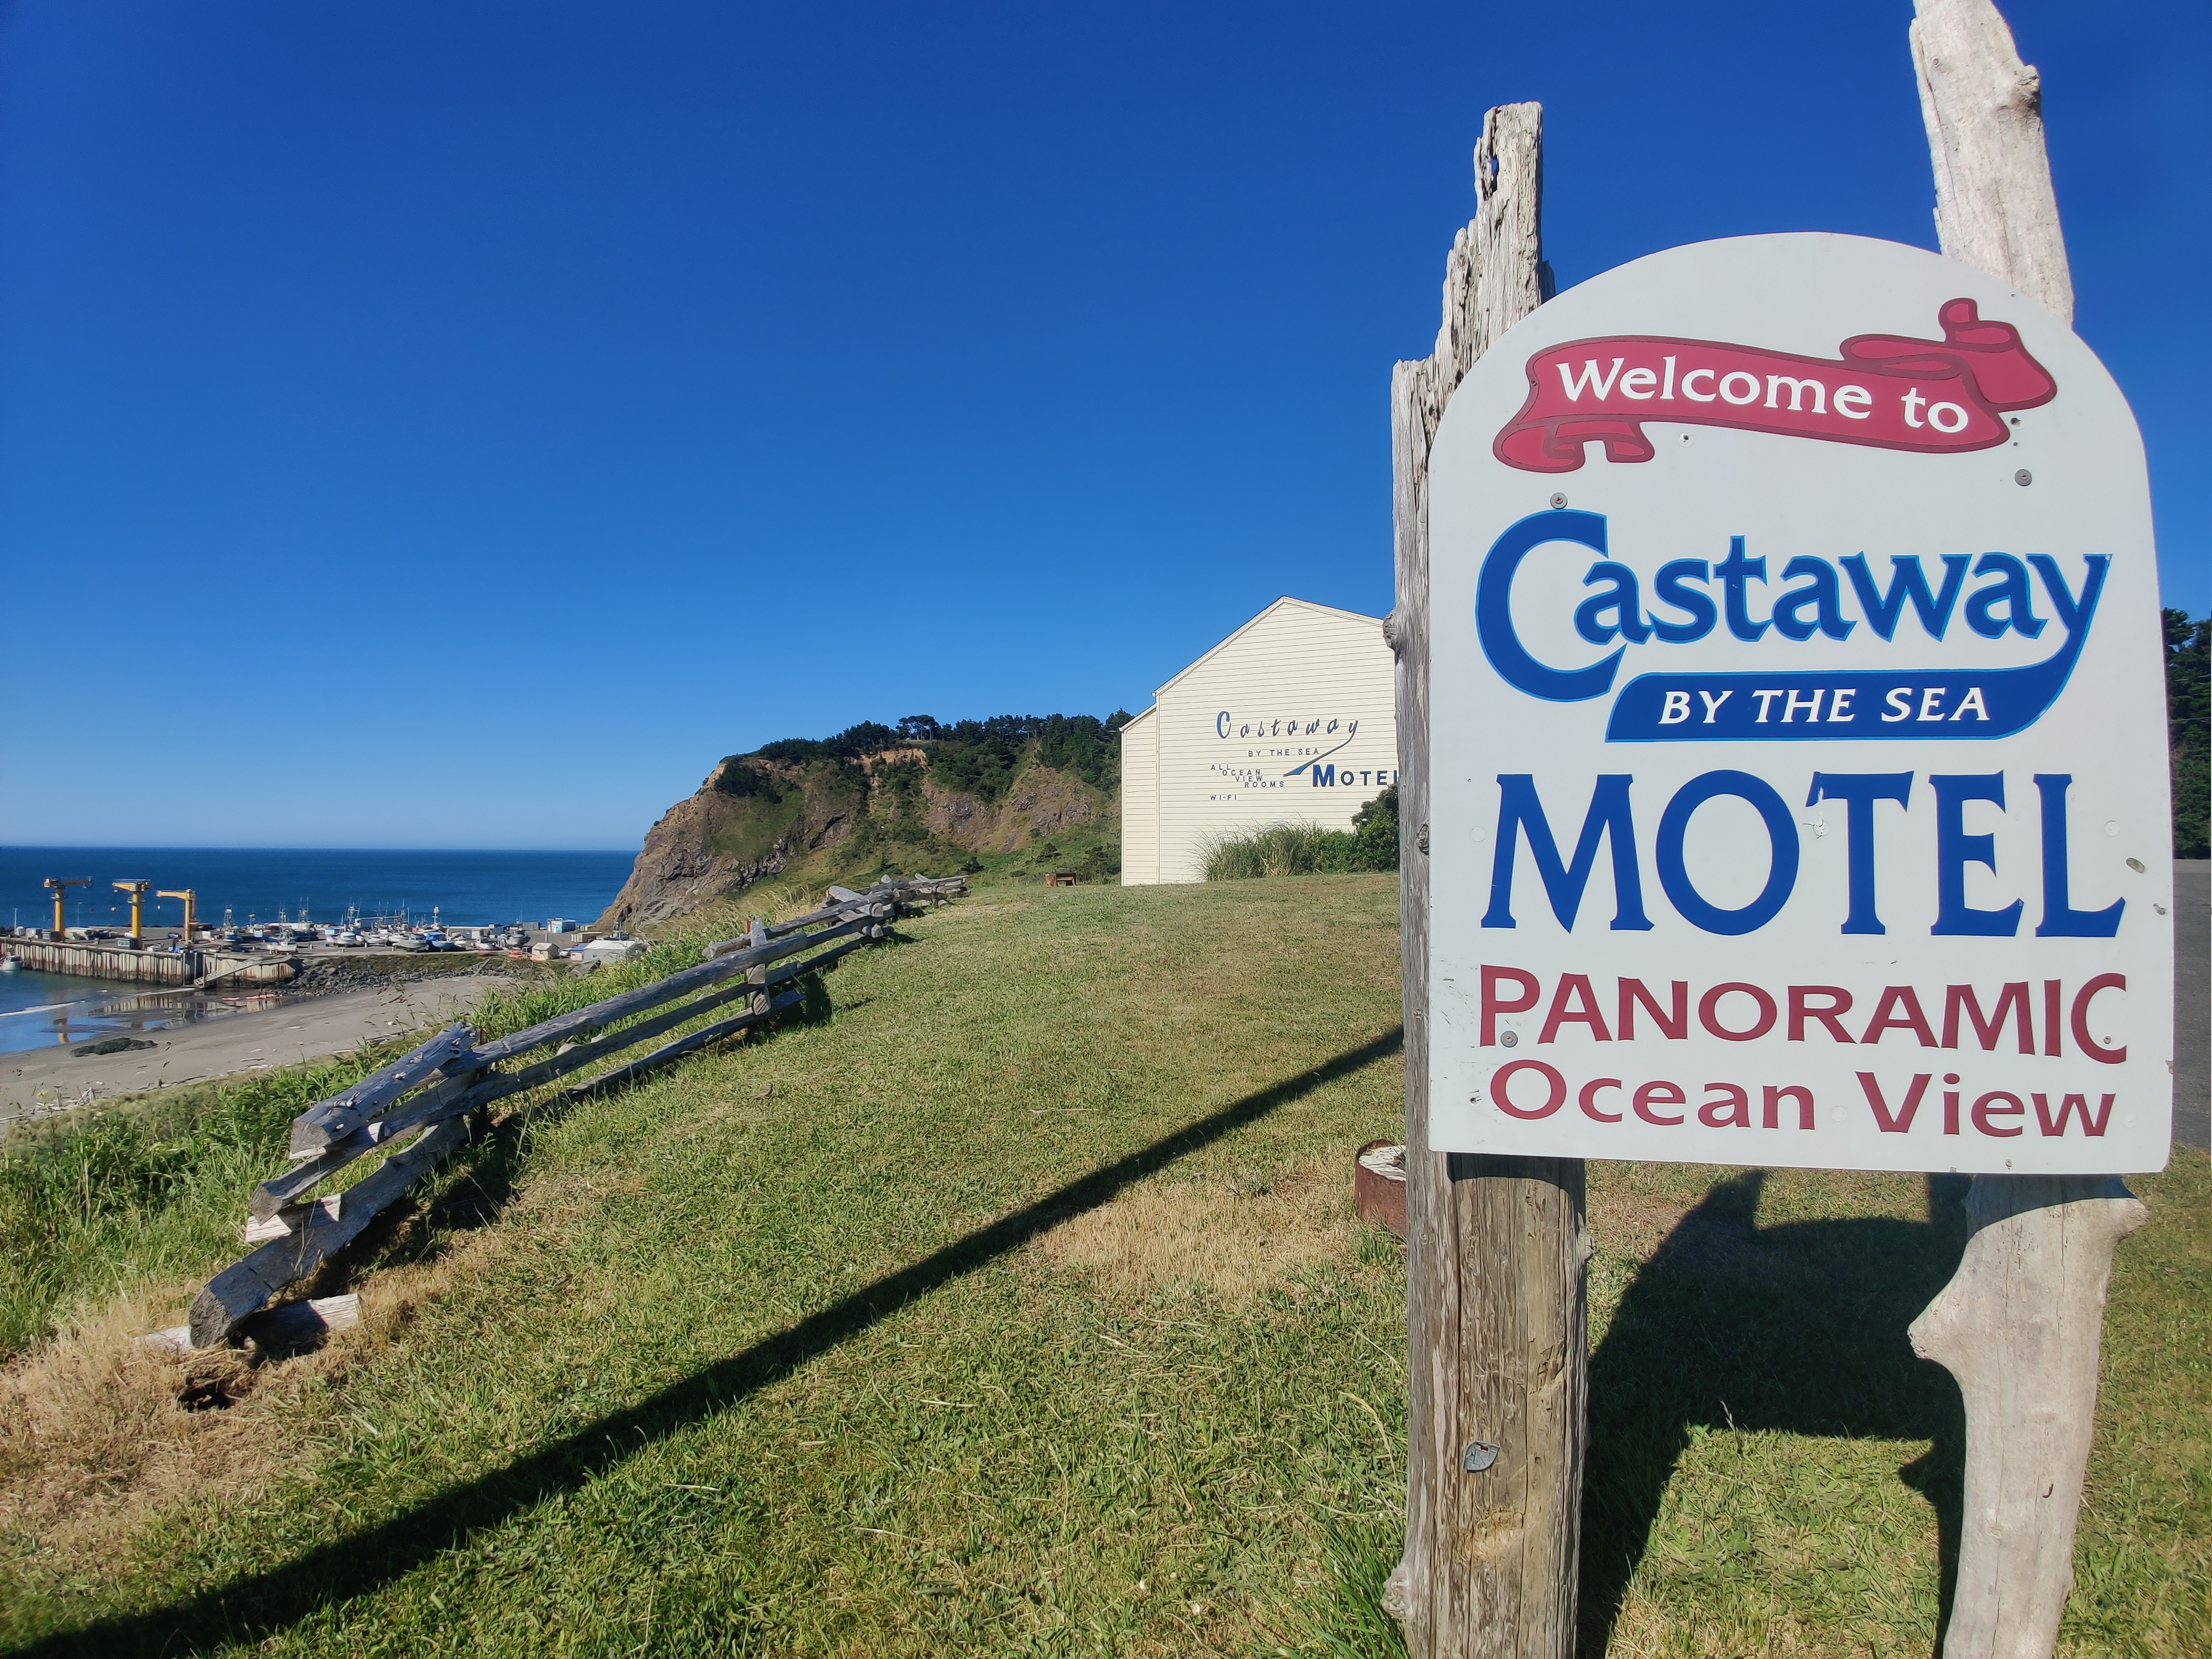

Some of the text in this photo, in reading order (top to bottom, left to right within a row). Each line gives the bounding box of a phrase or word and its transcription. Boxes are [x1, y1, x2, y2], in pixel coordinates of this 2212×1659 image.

[1555, 356, 1969, 434] Welcome to
[1476, 509, 2112, 723] Castaway
[1217, 711, 1358, 750] Castaway
[1660, 688, 1991, 725] BY THE SEA
[1480, 769, 2126, 938] MOTEL
[1479, 964, 2127, 1065] PANORAMIC
[1489, 1058, 2116, 1138] Ocean View
